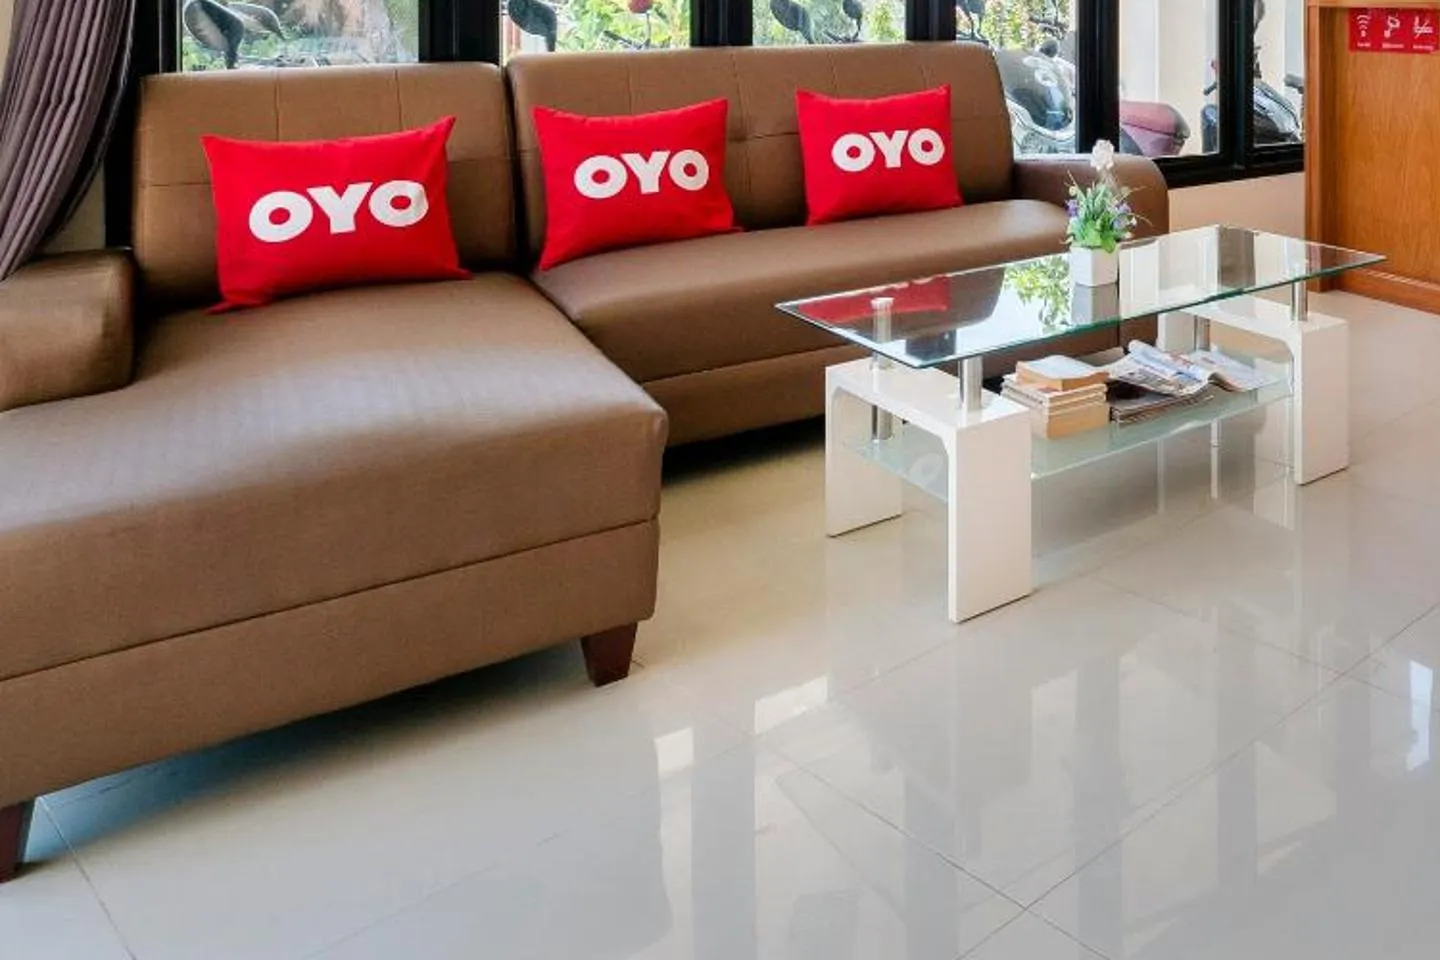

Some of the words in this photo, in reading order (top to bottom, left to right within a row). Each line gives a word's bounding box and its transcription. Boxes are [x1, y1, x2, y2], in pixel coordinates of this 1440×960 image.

[574, 149, 710, 200] OYO
[832, 128, 946, 172] OYO
[248, 180, 429, 242] OYO
